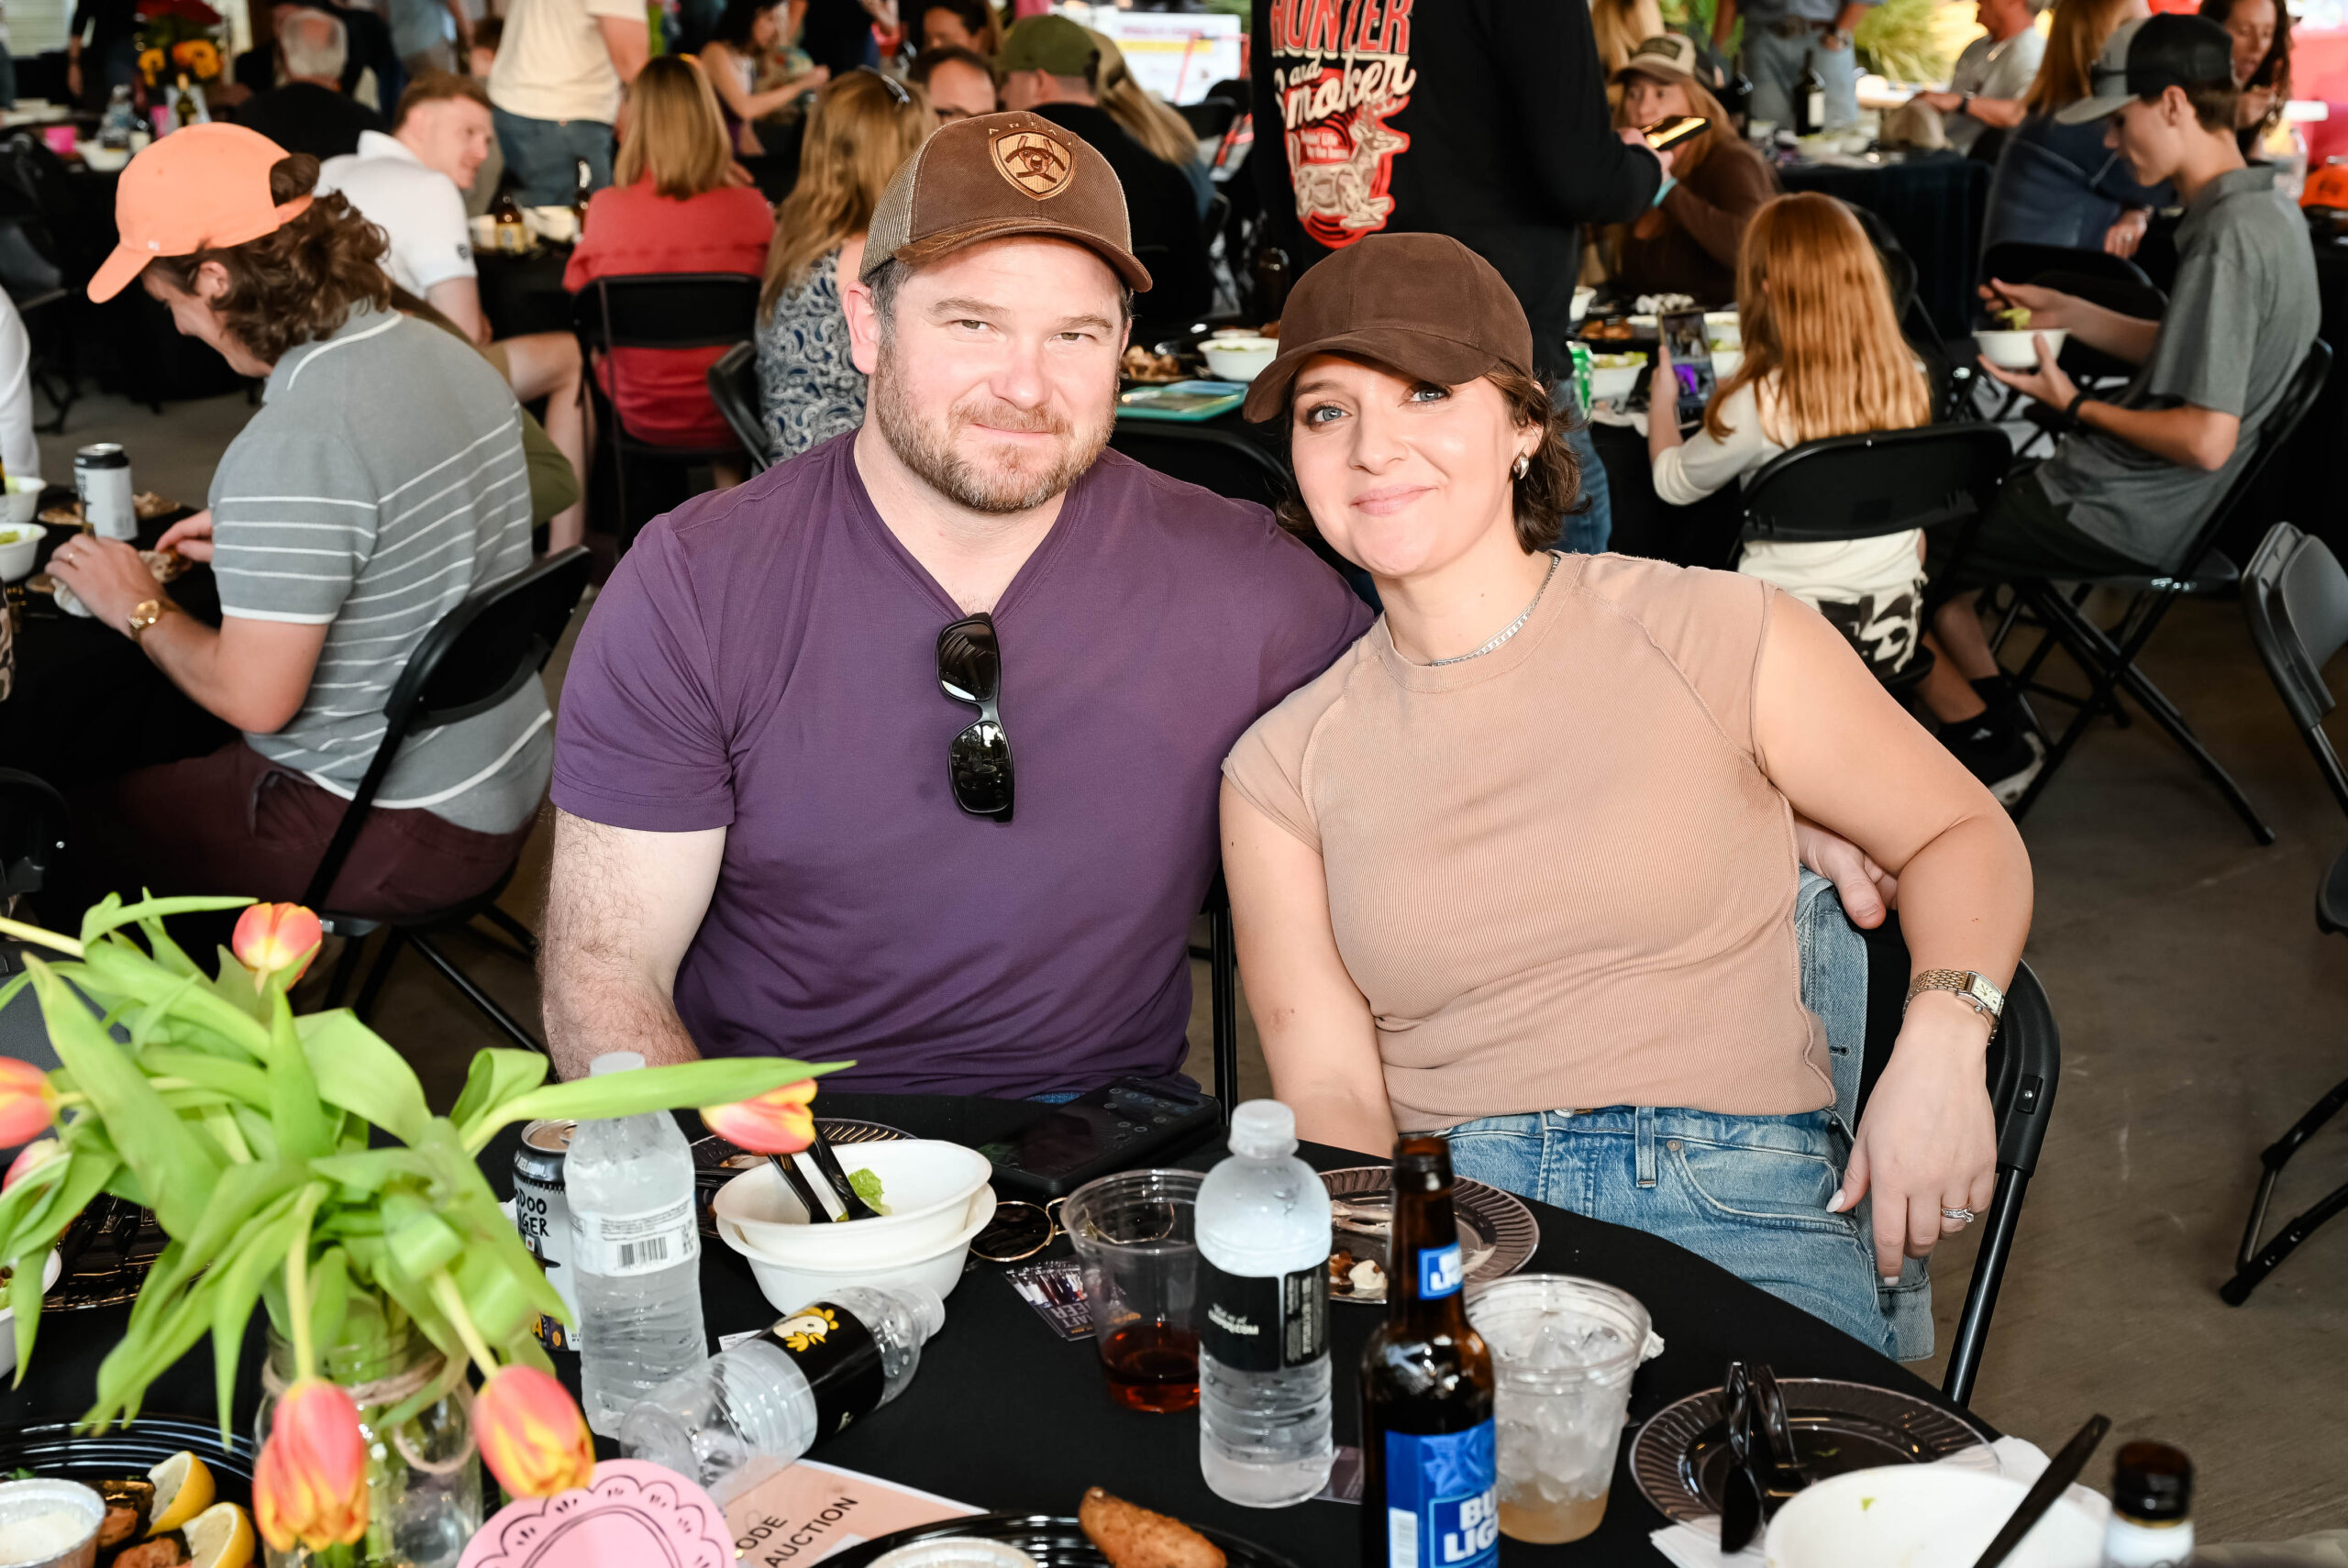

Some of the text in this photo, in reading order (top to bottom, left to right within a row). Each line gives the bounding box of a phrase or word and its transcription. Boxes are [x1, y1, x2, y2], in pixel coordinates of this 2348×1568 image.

[1270, 0, 1413, 58] HUNTER
[1289, 47, 1324, 86] and
[764, 1496, 858, 1568] AUCTION
